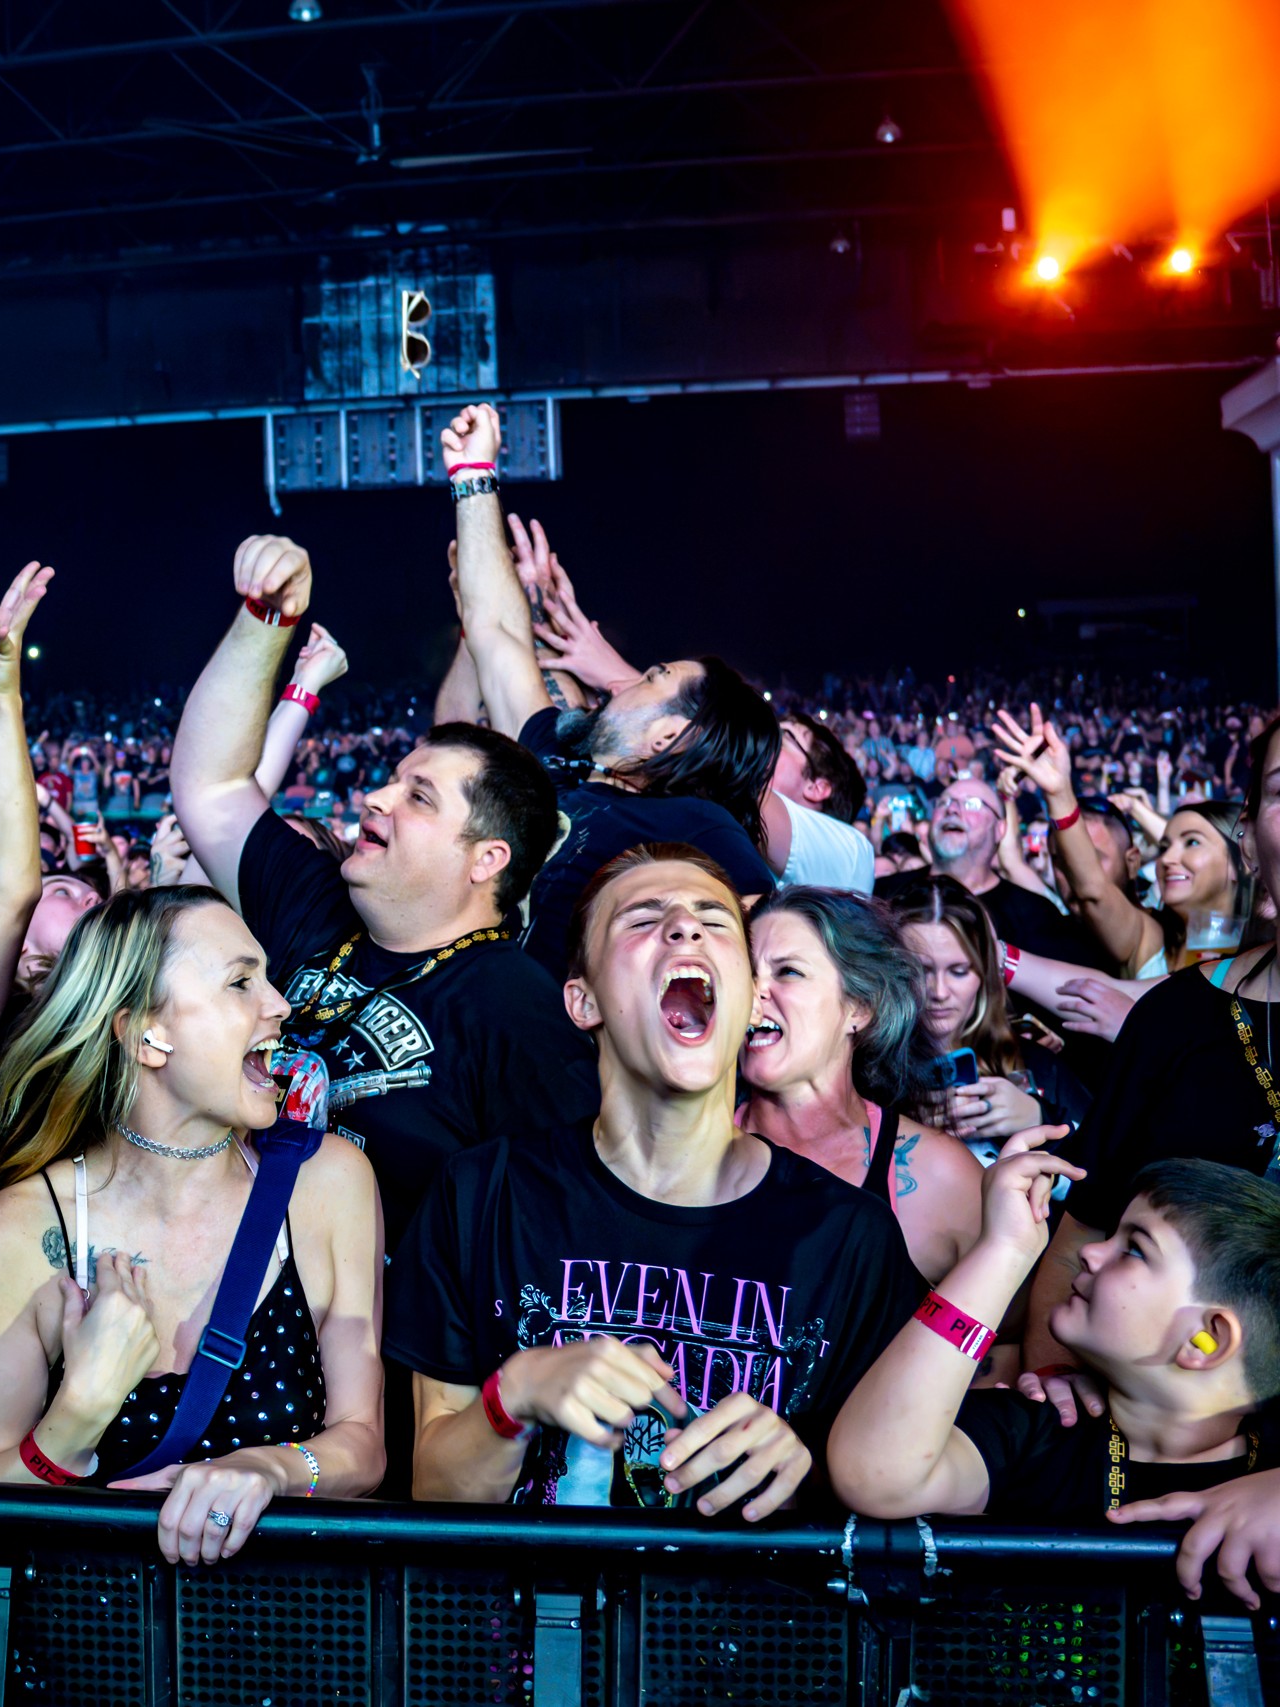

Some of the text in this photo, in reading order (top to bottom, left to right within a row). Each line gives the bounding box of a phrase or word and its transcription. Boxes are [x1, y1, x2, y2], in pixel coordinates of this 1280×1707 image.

[559, 1259, 793, 1349] EVEN IN
[921, 1297, 972, 1340] PIT PI
[30, 1454, 55, 1477] PIT
